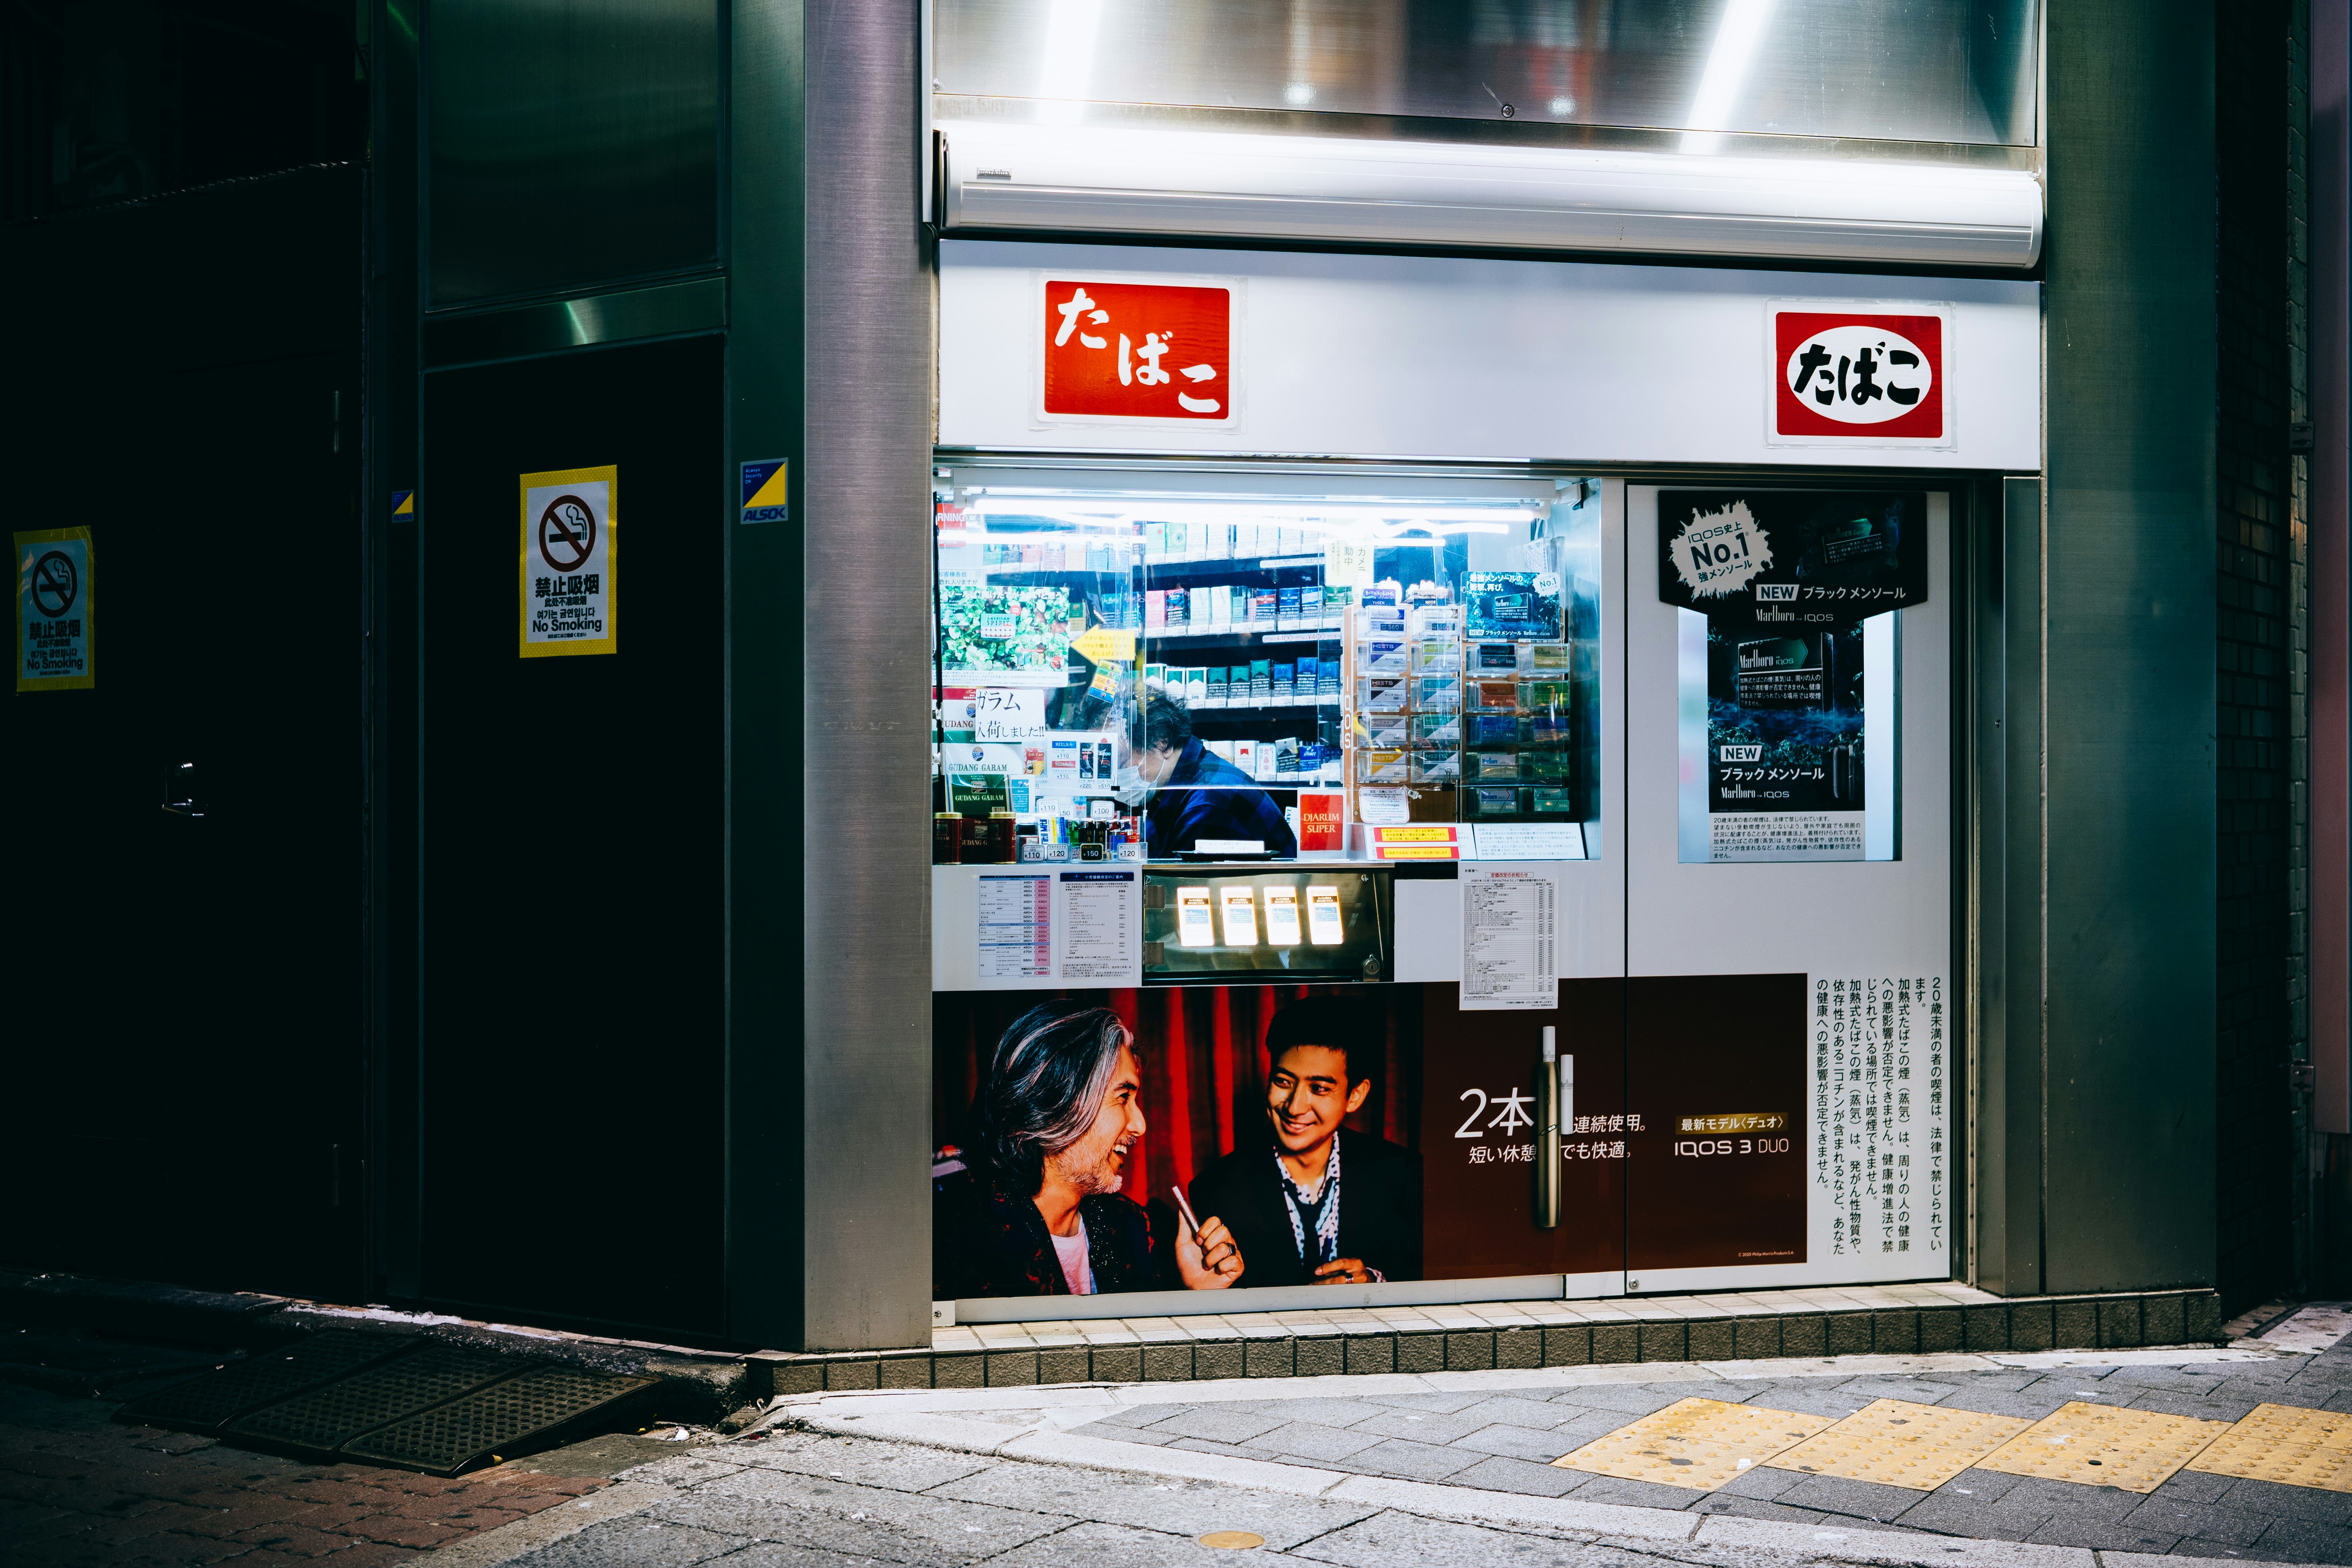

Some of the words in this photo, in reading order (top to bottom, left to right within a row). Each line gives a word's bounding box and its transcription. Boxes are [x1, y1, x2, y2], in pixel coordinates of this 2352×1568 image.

[1055, 287, 1220, 413] たばこ
[1793, 341, 1920, 405] たばこ
[743, 507, 786, 521] ALSOK
[937, 513, 965, 522] RNING
[1688, 521, 1743, 544] IQOS史上
[1690, 531, 1750, 571] No.1
[1470, 575, 1523, 583] 最強メンソールの
[1698, 559, 1753, 583] 強メンソール
[535, 573, 599, 598] 禁止吸烟
[1470, 583, 1504, 592] 衝撃、再び。
[1539, 578, 1557, 588] No.1
[1761, 586, 1795, 599] NEW
[1803, 587, 1846, 599] ブラック
[1850, 587, 1906, 599] メンソール
[544, 596, 587, 608] 此处不准吸烟
[537, 610, 558, 620] 여기는
[559, 607, 595, 618] 금연입니다
[1756, 605, 1795, 622] Marlboro
[1805, 614, 1833, 622] IQOS
[29, 619, 80, 640] 禁止吸烟
[532, 619, 549, 632] No
[551, 618, 602, 632] Smoking
[27, 659, 40, 670] No
[42, 657, 83, 670] Smoking
[1740, 649, 1773, 669] Marlboro
[976, 690, 1021, 712] ガラム
[1725, 747, 1757, 760] NEW
[948, 763, 980, 772] GUDANG
[1720, 768, 1764, 781] ブラック
[1768, 767, 1824, 780] メンソール
[1721, 783, 1755, 799] Marlboro
[1303, 813, 1340, 823] DJARUM
[1307, 825, 1336, 833] SUPER
[1915, 977, 1926, 1007] ます。
[1817, 979, 1828, 1189] の健康への悪影響が否定できません。
[1454, 1087, 1537, 1138] 2本
[1573, 1114, 1646, 1134] 連続使用。
[1681, 1116, 1783, 1132] 最新モデル〈デュオ〉
[1675, 1140, 1733, 1158] IQOS
[1739, 1140, 1751, 1154] 3
[1758, 1138, 1789, 1153] DUO
